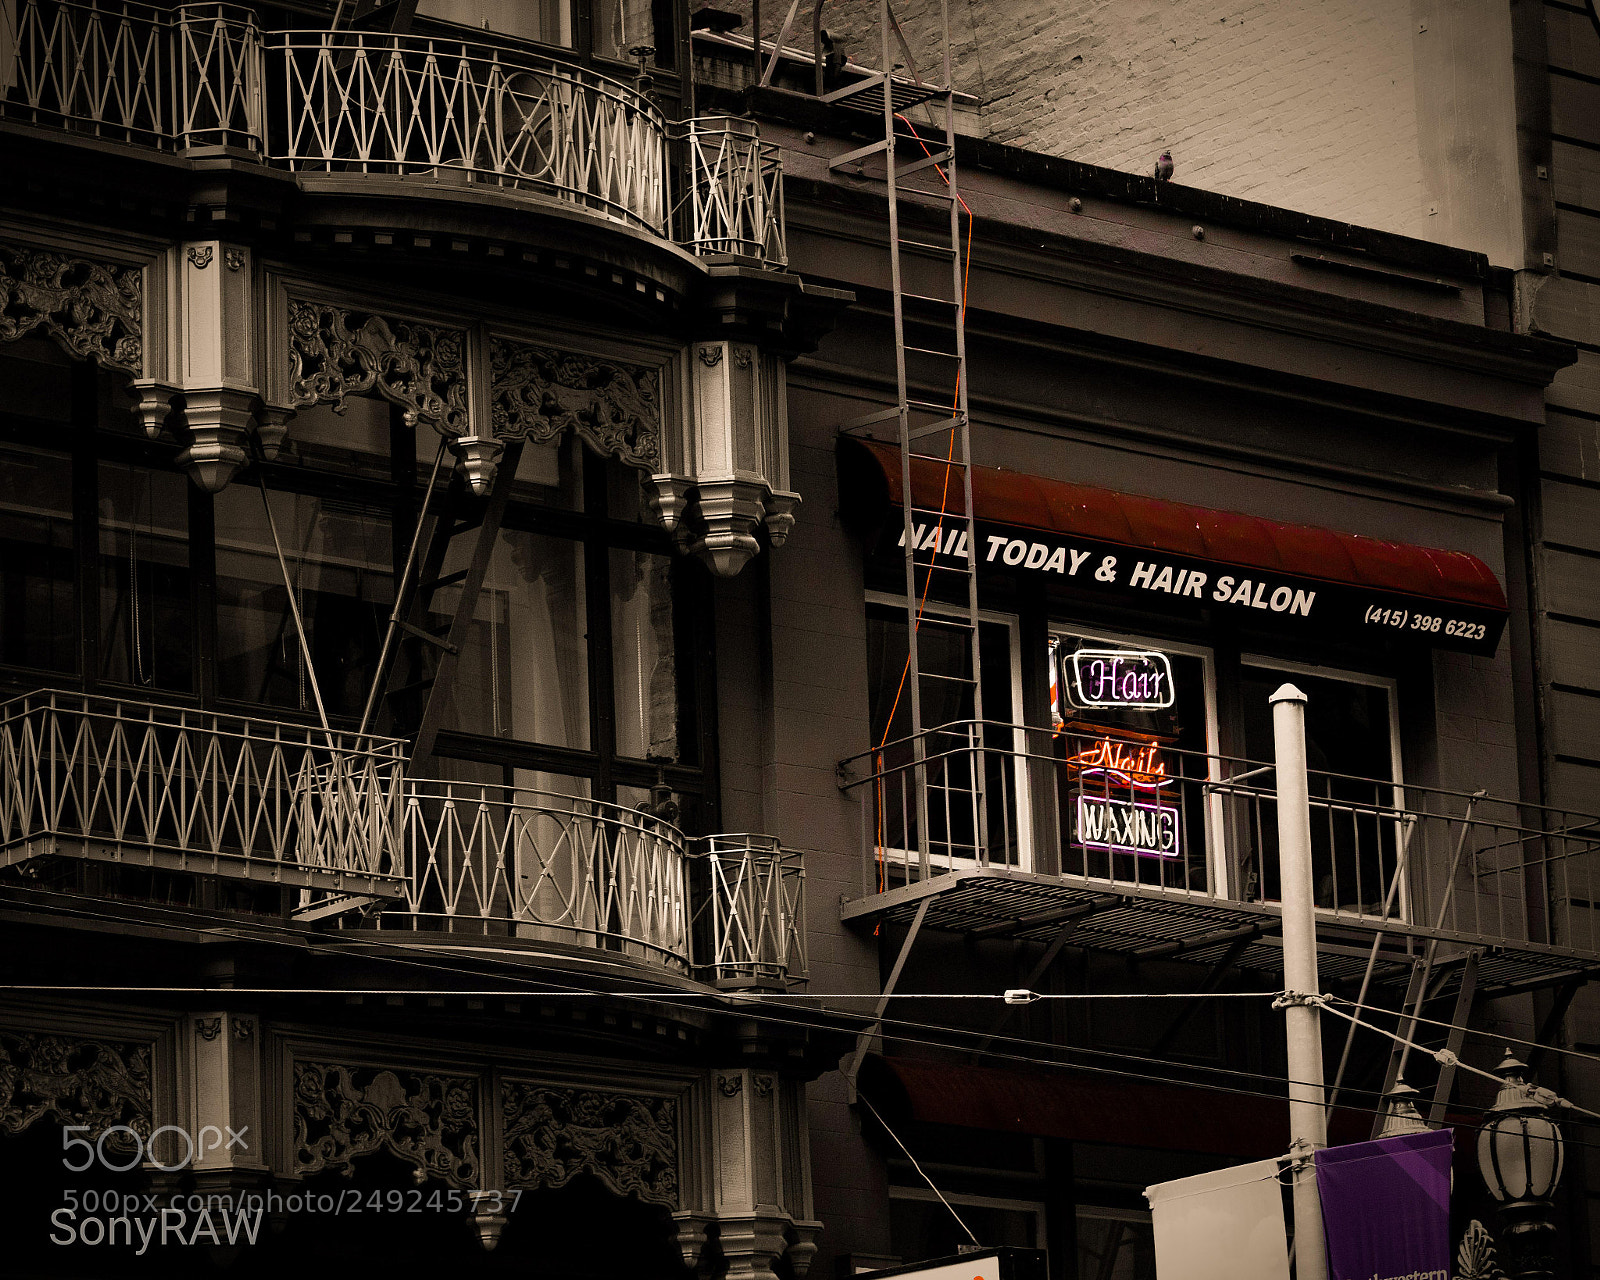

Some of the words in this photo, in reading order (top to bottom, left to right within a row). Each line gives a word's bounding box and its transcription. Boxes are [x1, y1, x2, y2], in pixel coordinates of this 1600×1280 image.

[898, 522, 972, 558] NAIL
[986, 535, 1090, 576] TODAY
[1094, 556, 1117, 582] &
[1130, 562, 1207, 598] HAIR
[1212, 576, 1316, 616] SALON
[1365, 604, 1408, 628] (415)
[1411, 614, 1442, 632] 398
[1445, 620, 1486, 640] 6223
[1090, 658, 1165, 700] Hair
[1083, 804, 1174, 849] WAXING
